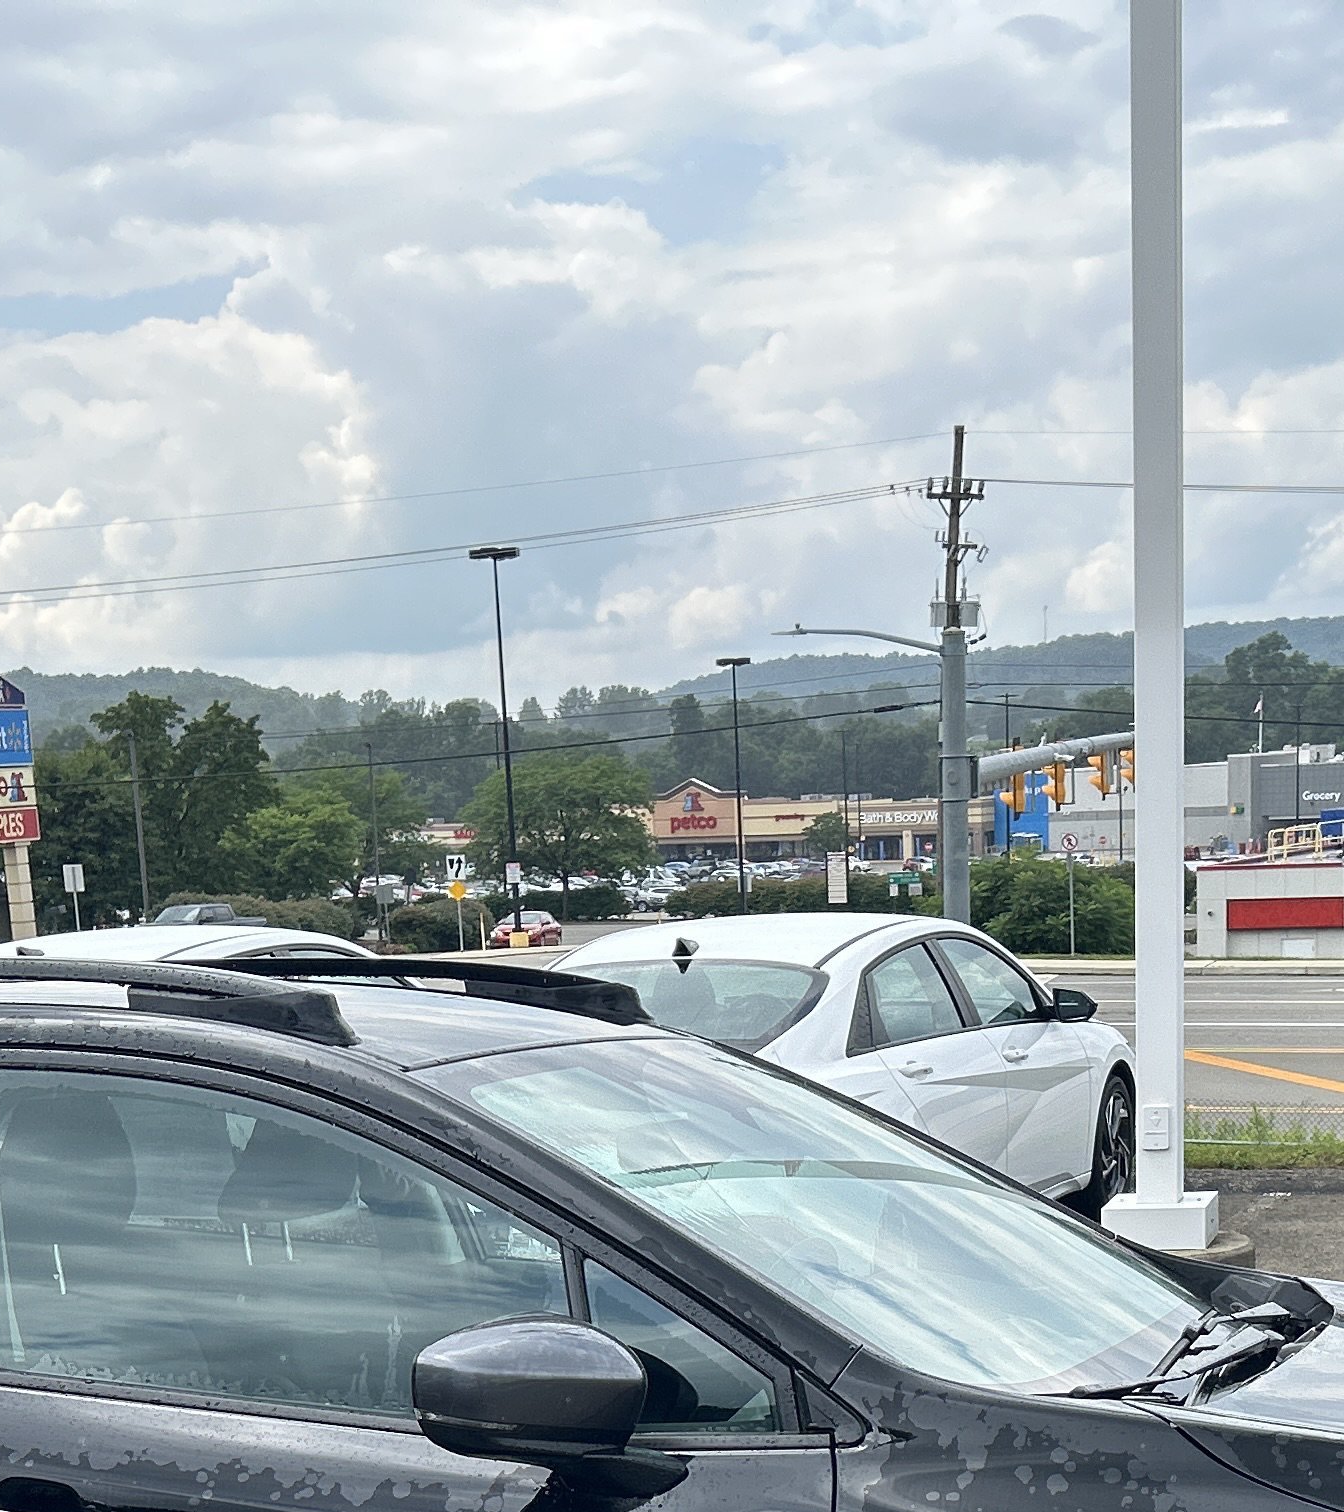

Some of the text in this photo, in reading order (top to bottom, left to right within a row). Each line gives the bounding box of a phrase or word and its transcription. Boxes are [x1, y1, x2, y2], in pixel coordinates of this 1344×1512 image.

[1302, 790, 1341, 802] Grocery
[670, 814, 717, 834] petco
[860, 811, 883, 824] Bath
[884, 812, 893, 823] &
[894, 811, 923, 825] Body
